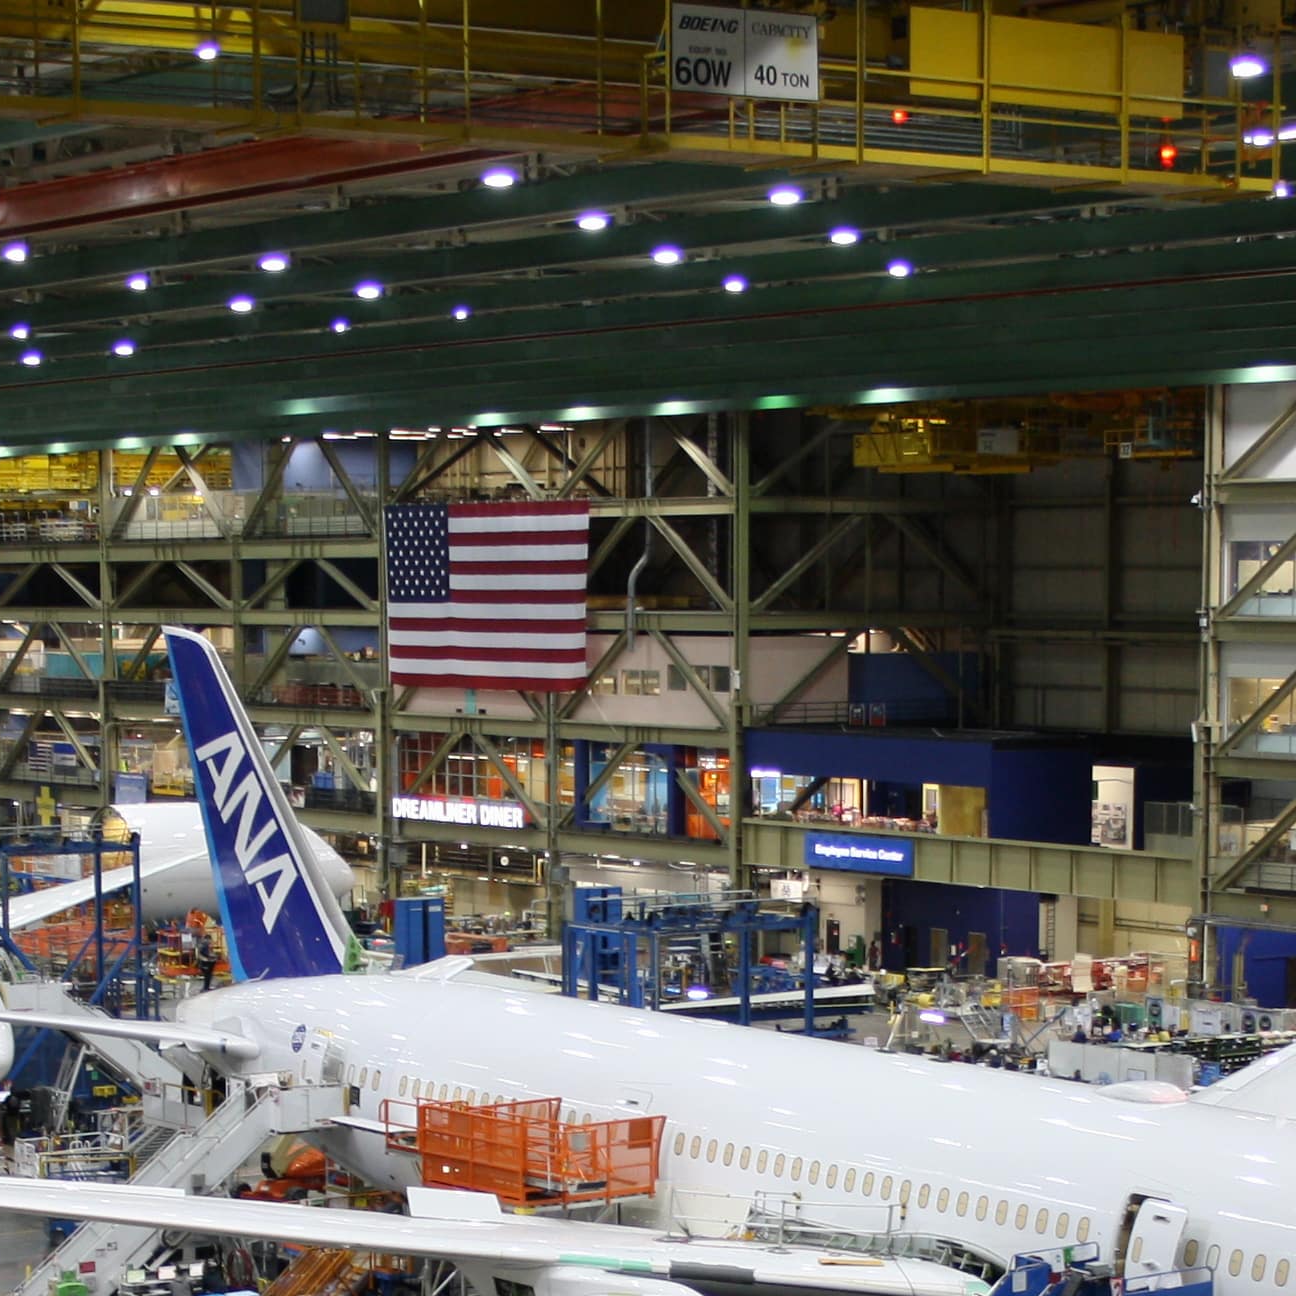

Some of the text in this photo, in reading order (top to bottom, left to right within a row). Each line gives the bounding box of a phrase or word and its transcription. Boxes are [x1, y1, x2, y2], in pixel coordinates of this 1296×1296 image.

[678, 15, 739, 34] BOEING
[751, 21, 812, 39] CAPACITY
[675, 56, 732, 88] 60W
[754, 64, 809, 88] 40 TON
[392, 797, 523, 828] DREAMLINER DINER
[195, 730, 298, 935] ANA
[878, 849, 904, 862] Center
